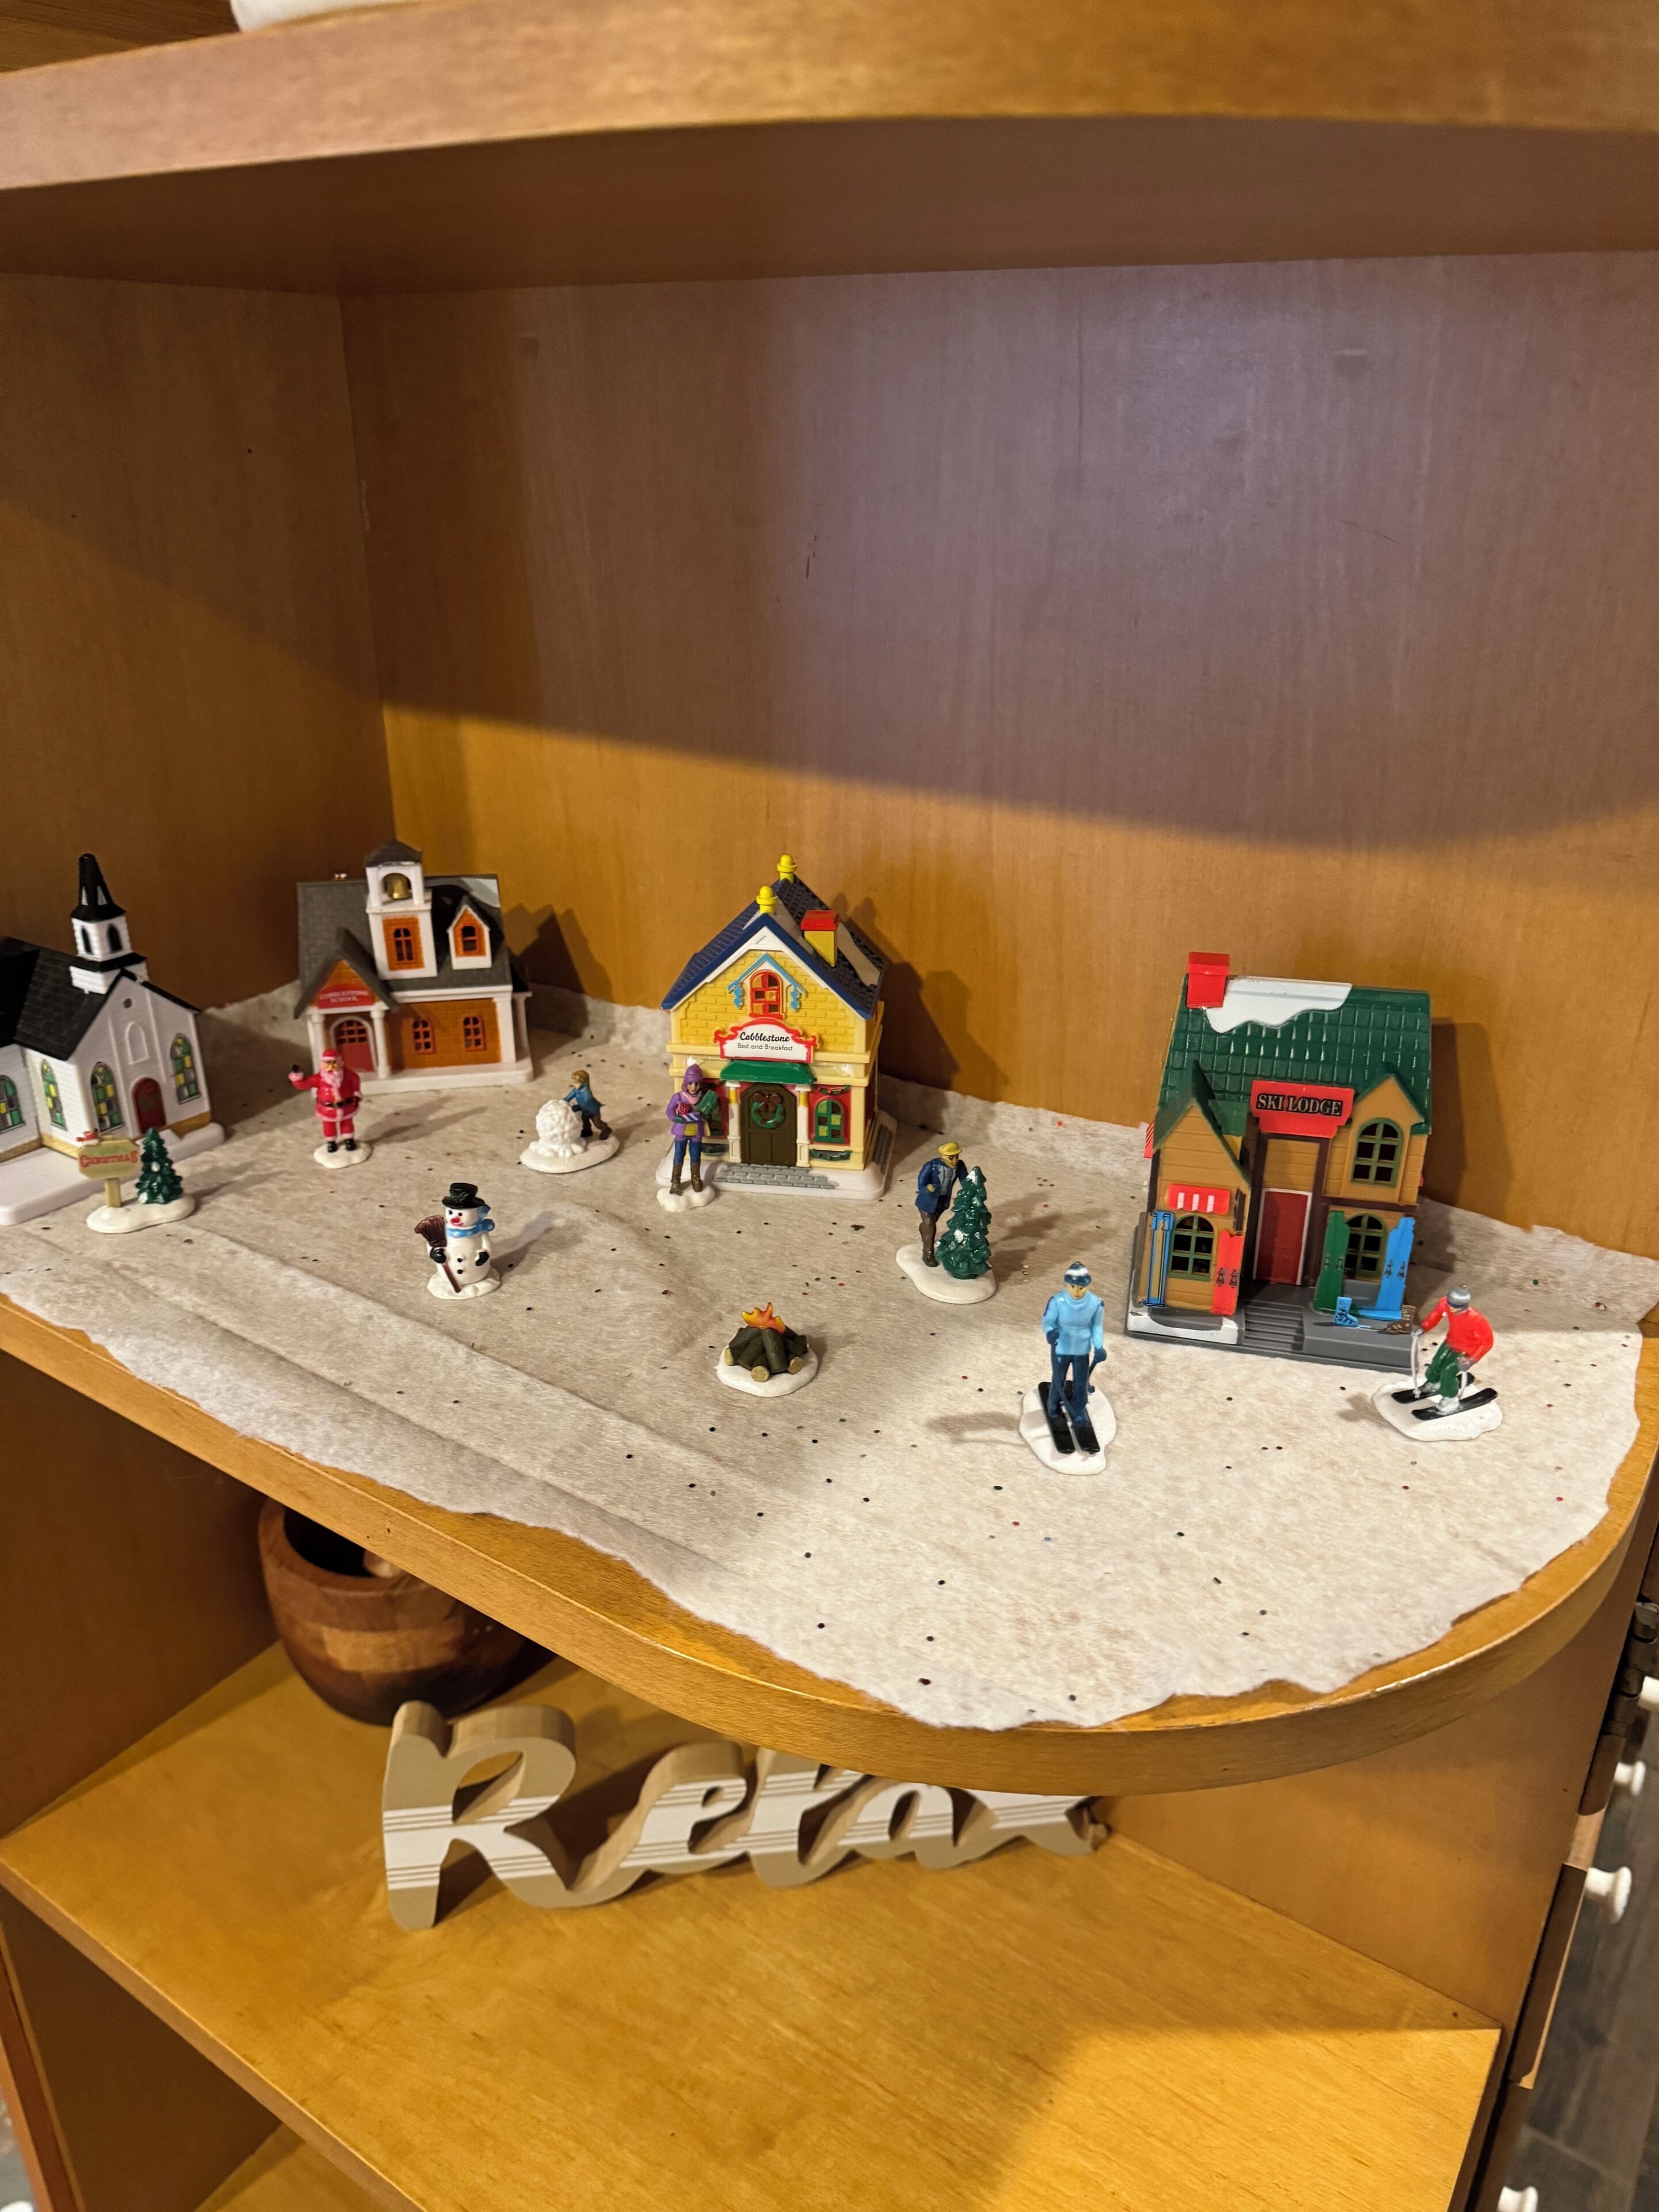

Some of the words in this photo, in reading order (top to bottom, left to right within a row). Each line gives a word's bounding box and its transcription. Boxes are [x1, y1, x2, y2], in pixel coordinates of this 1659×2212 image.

[740, 1032, 791, 1042] Cobblestone
[1257, 1093, 1285, 1110] SKI
[1286, 1096, 1342, 1115] LODGE
